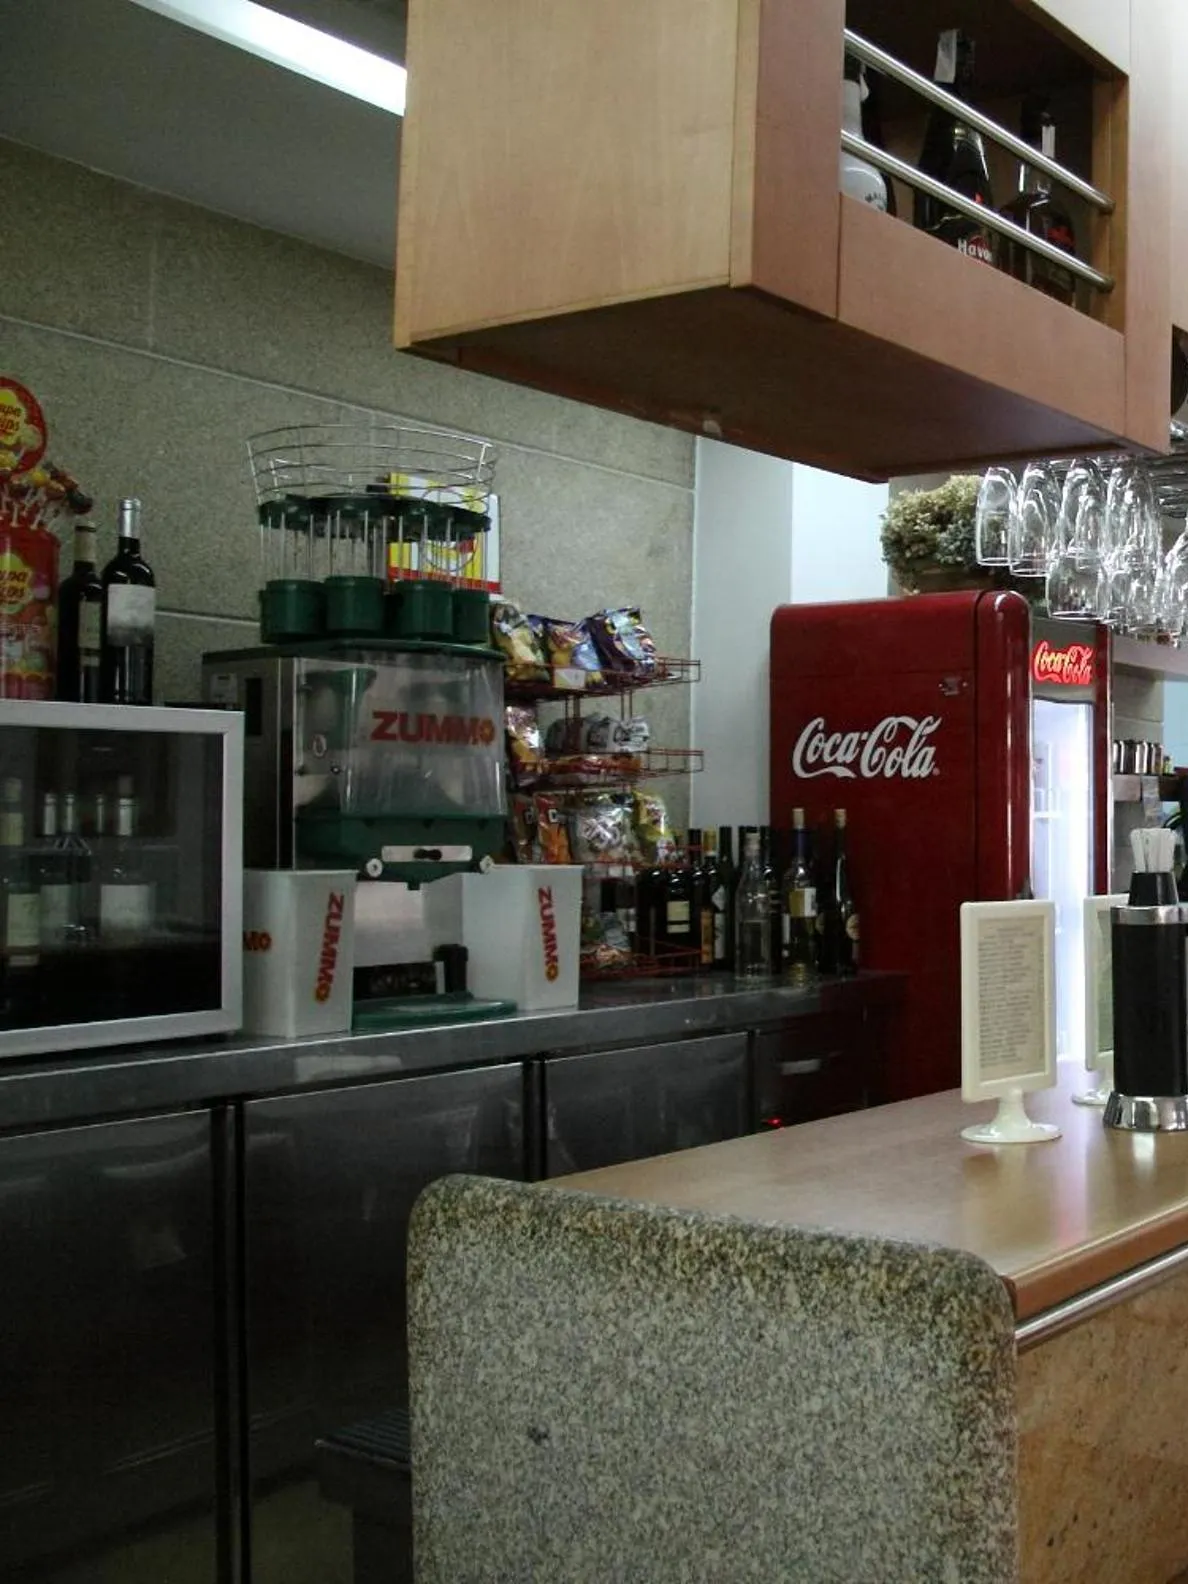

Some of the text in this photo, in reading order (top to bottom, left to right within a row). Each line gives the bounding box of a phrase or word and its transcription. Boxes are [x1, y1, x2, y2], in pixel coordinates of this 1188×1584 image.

[1033, 640, 1094, 685] Coca-Cola
[370, 710, 496, 747] ZUMMO
[792, 715, 942, 778] Coca-Cola
[315, 891, 345, 1003] ZUMMO
[538, 885, 559, 983] ZUMMO
